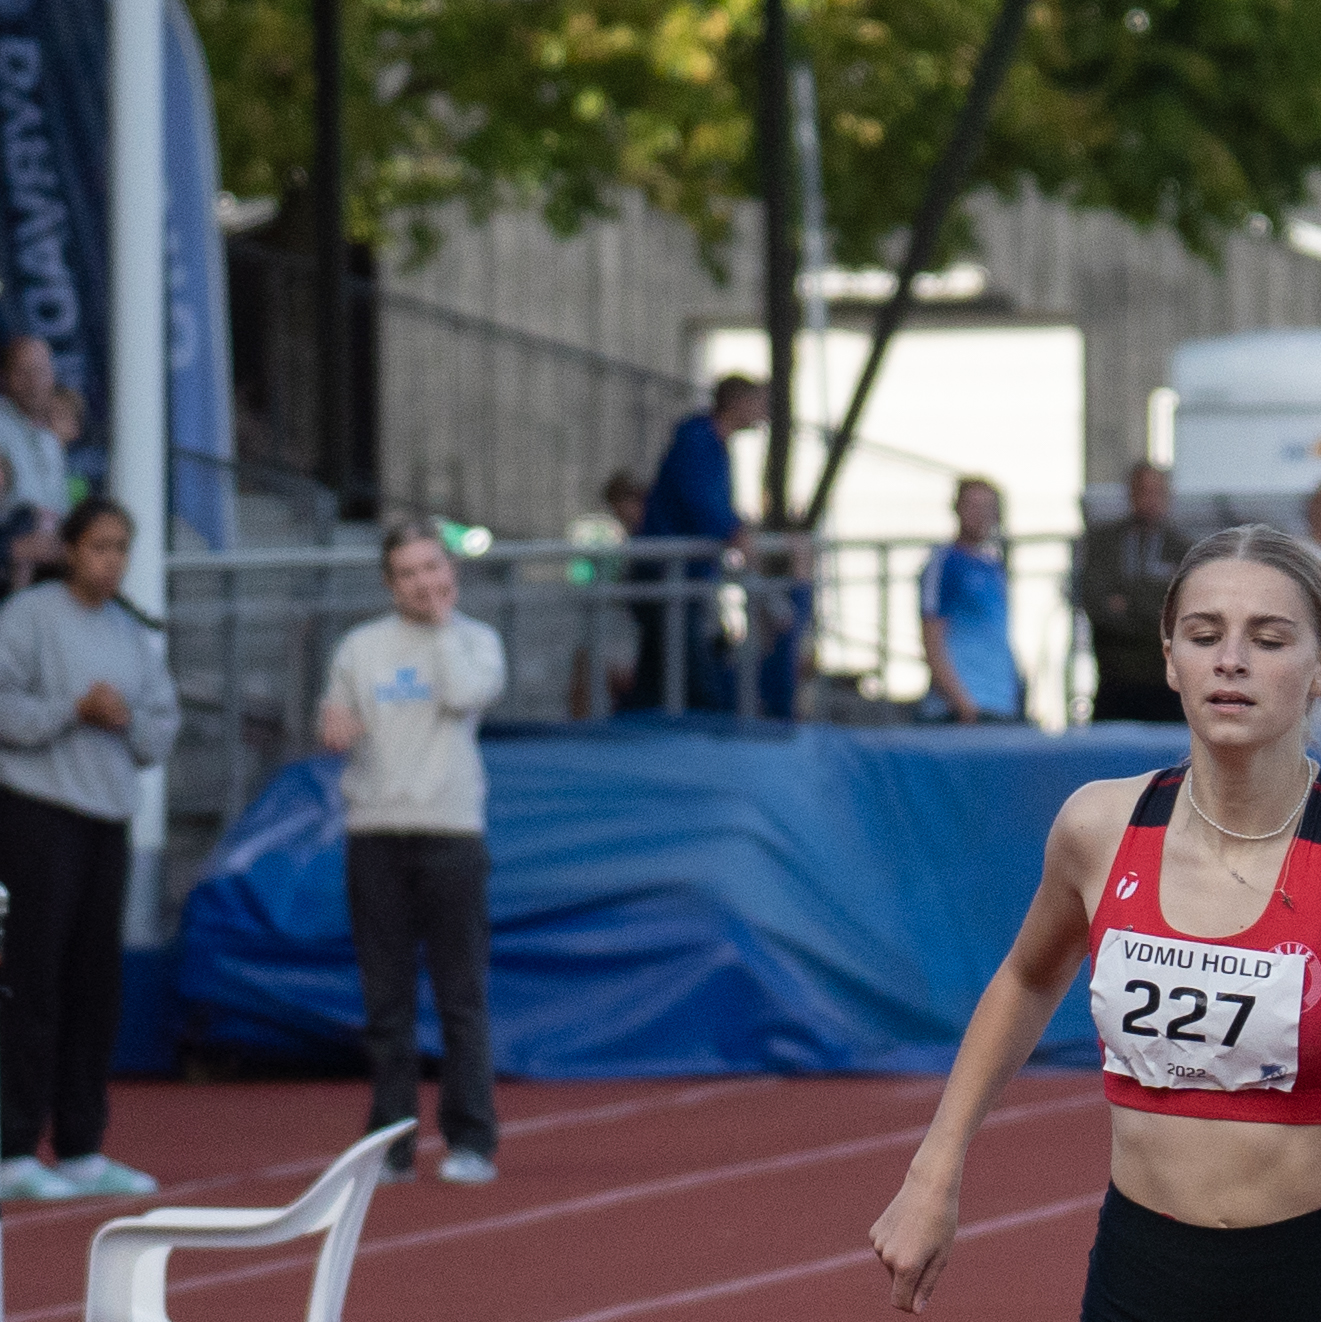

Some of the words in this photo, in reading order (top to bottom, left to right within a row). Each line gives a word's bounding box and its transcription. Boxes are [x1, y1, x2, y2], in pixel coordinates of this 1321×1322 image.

[1124, 940, 1194, 970] VDMU
[1201, 953, 1272, 979] HOLD
[1122, 980, 1257, 1048] 227
[1167, 1062, 1206, 1078] 2022
